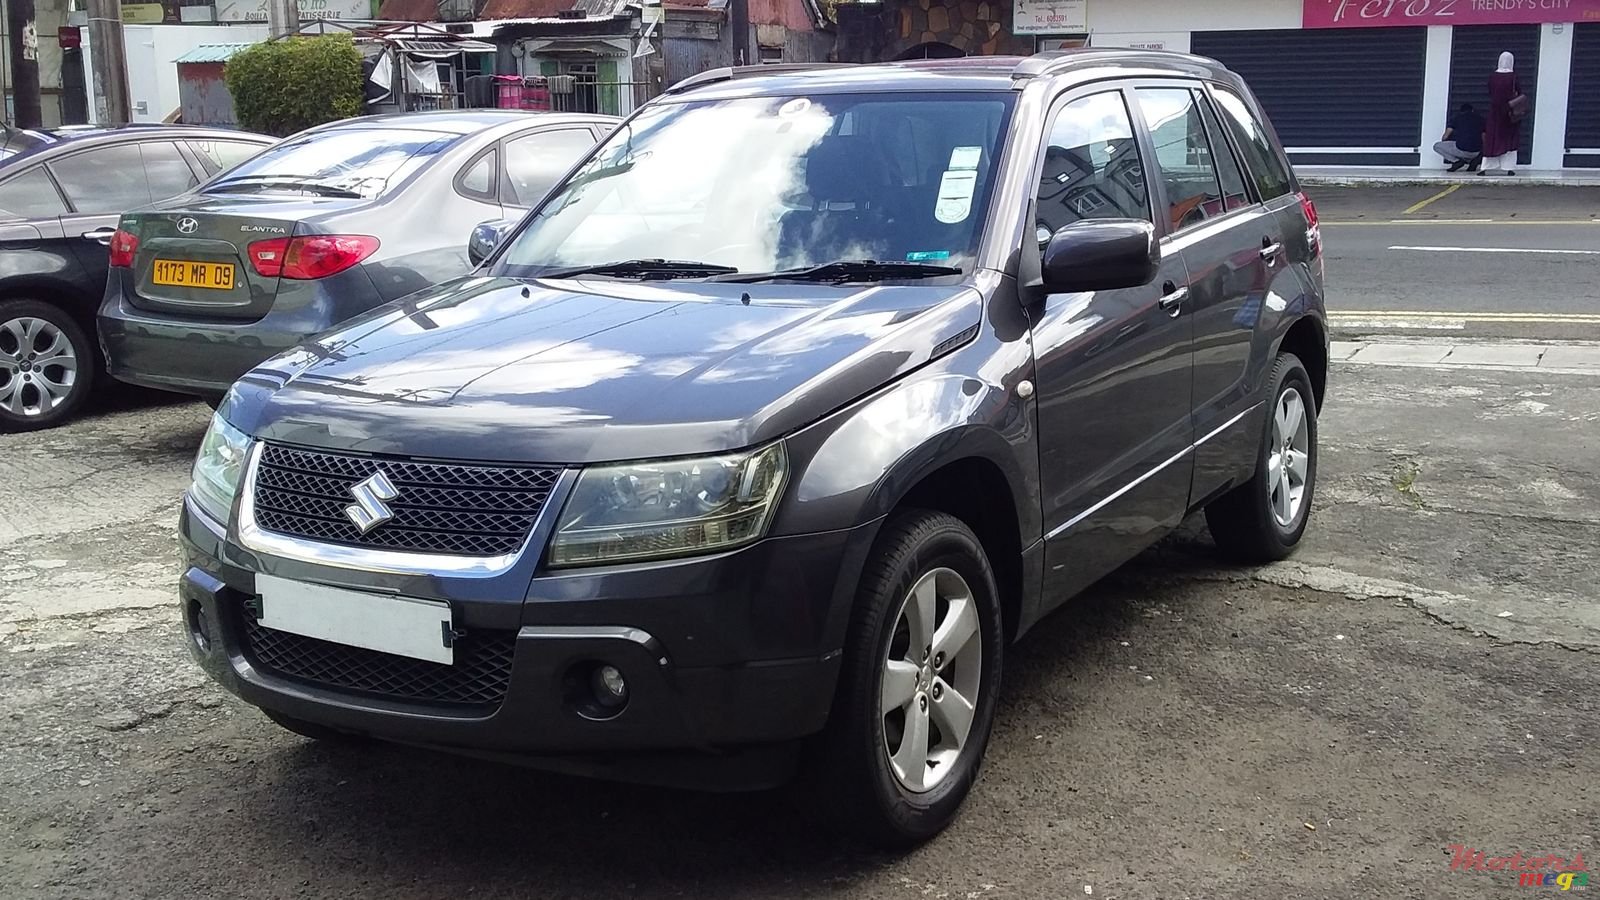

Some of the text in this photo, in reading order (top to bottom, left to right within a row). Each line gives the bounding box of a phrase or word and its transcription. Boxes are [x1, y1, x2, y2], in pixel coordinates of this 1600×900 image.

[1471, 0, 1571, 11] TRENDY'S CITY
[240, 225, 286, 234] ELANTRA
[190, 263, 206, 284] MR
[214, 266, 231, 286] 09
